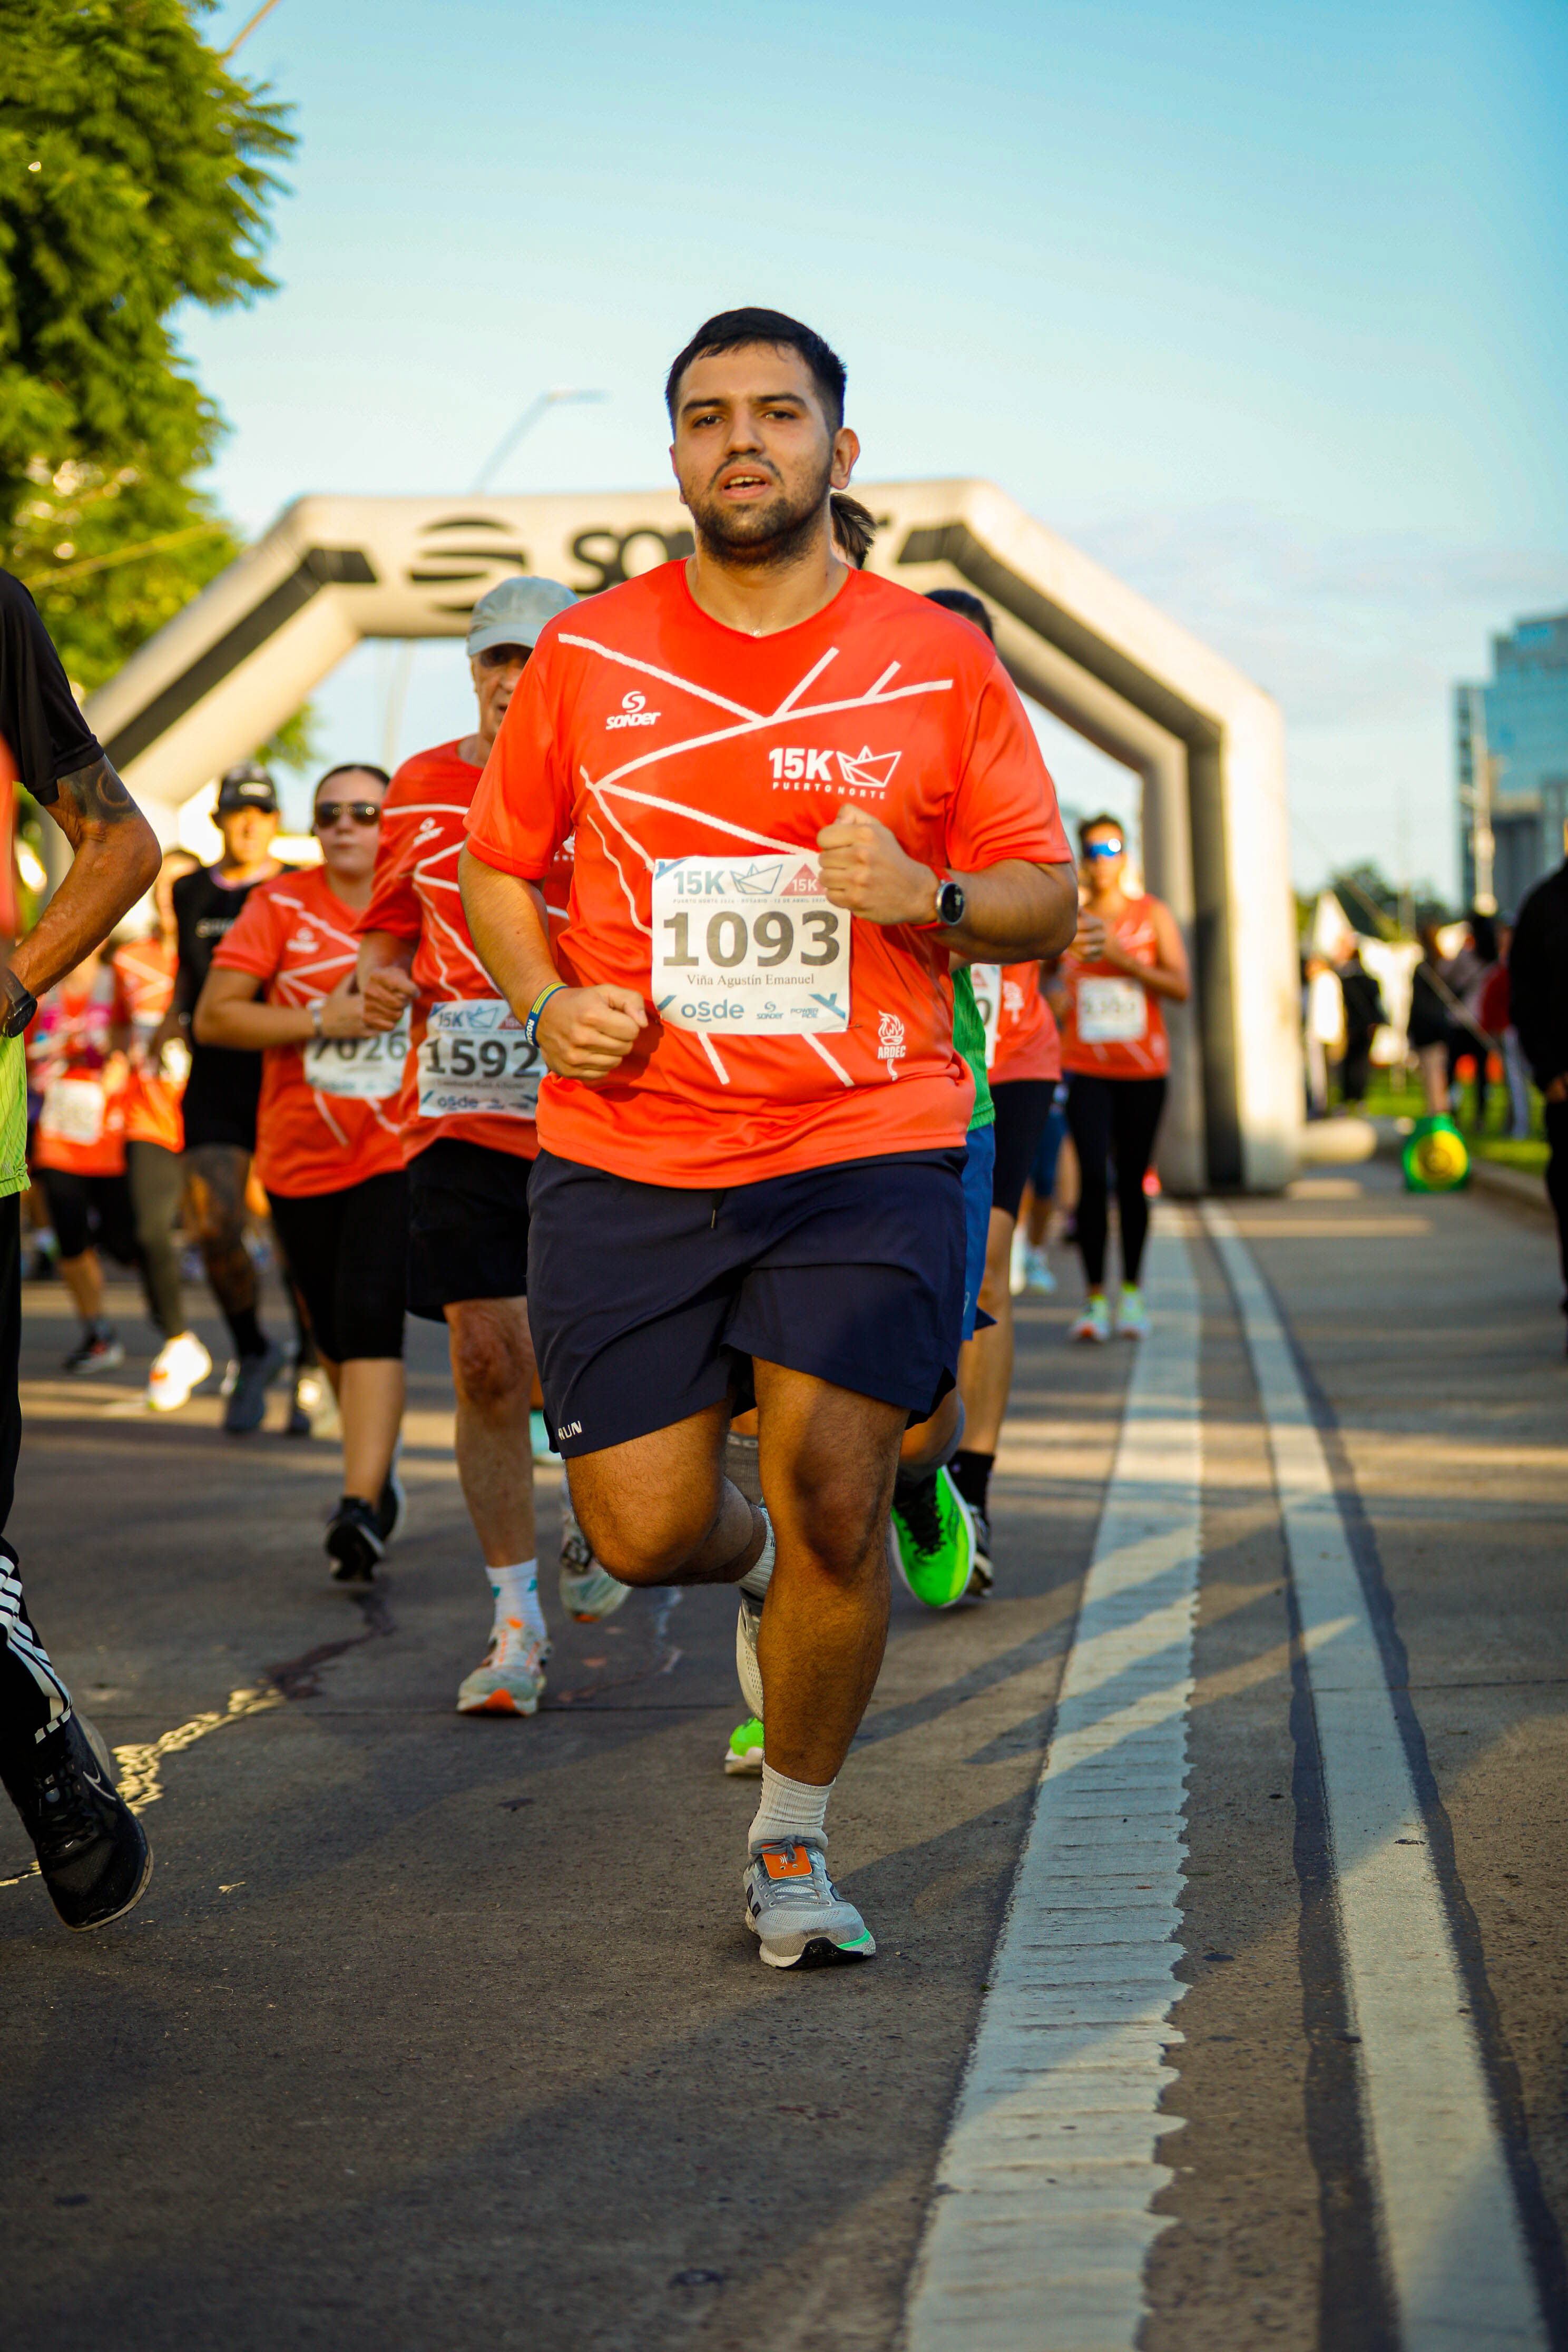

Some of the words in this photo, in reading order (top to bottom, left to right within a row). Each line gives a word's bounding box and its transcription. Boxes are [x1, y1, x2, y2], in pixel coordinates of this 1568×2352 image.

[769, 748, 835, 781] 15K
[772, 781, 832, 792] PUERTO
[838, 787, 886, 800] NORTE
[673, 870, 726, 895] 15K
[792, 878, 818, 892] 15K
[663, 910, 840, 967] 1093
[687, 974, 713, 985] Viña
[718, 974, 761, 988] Agustín
[766, 973, 815, 985] Emanuel
[438, 1011, 463, 1027] 15K
[681, 999, 744, 1022] osde
[425, 1037, 541, 1078] 1592
[877, 1045, 906, 1060] ARDEC
[557, 1420, 582, 1440] RUN
